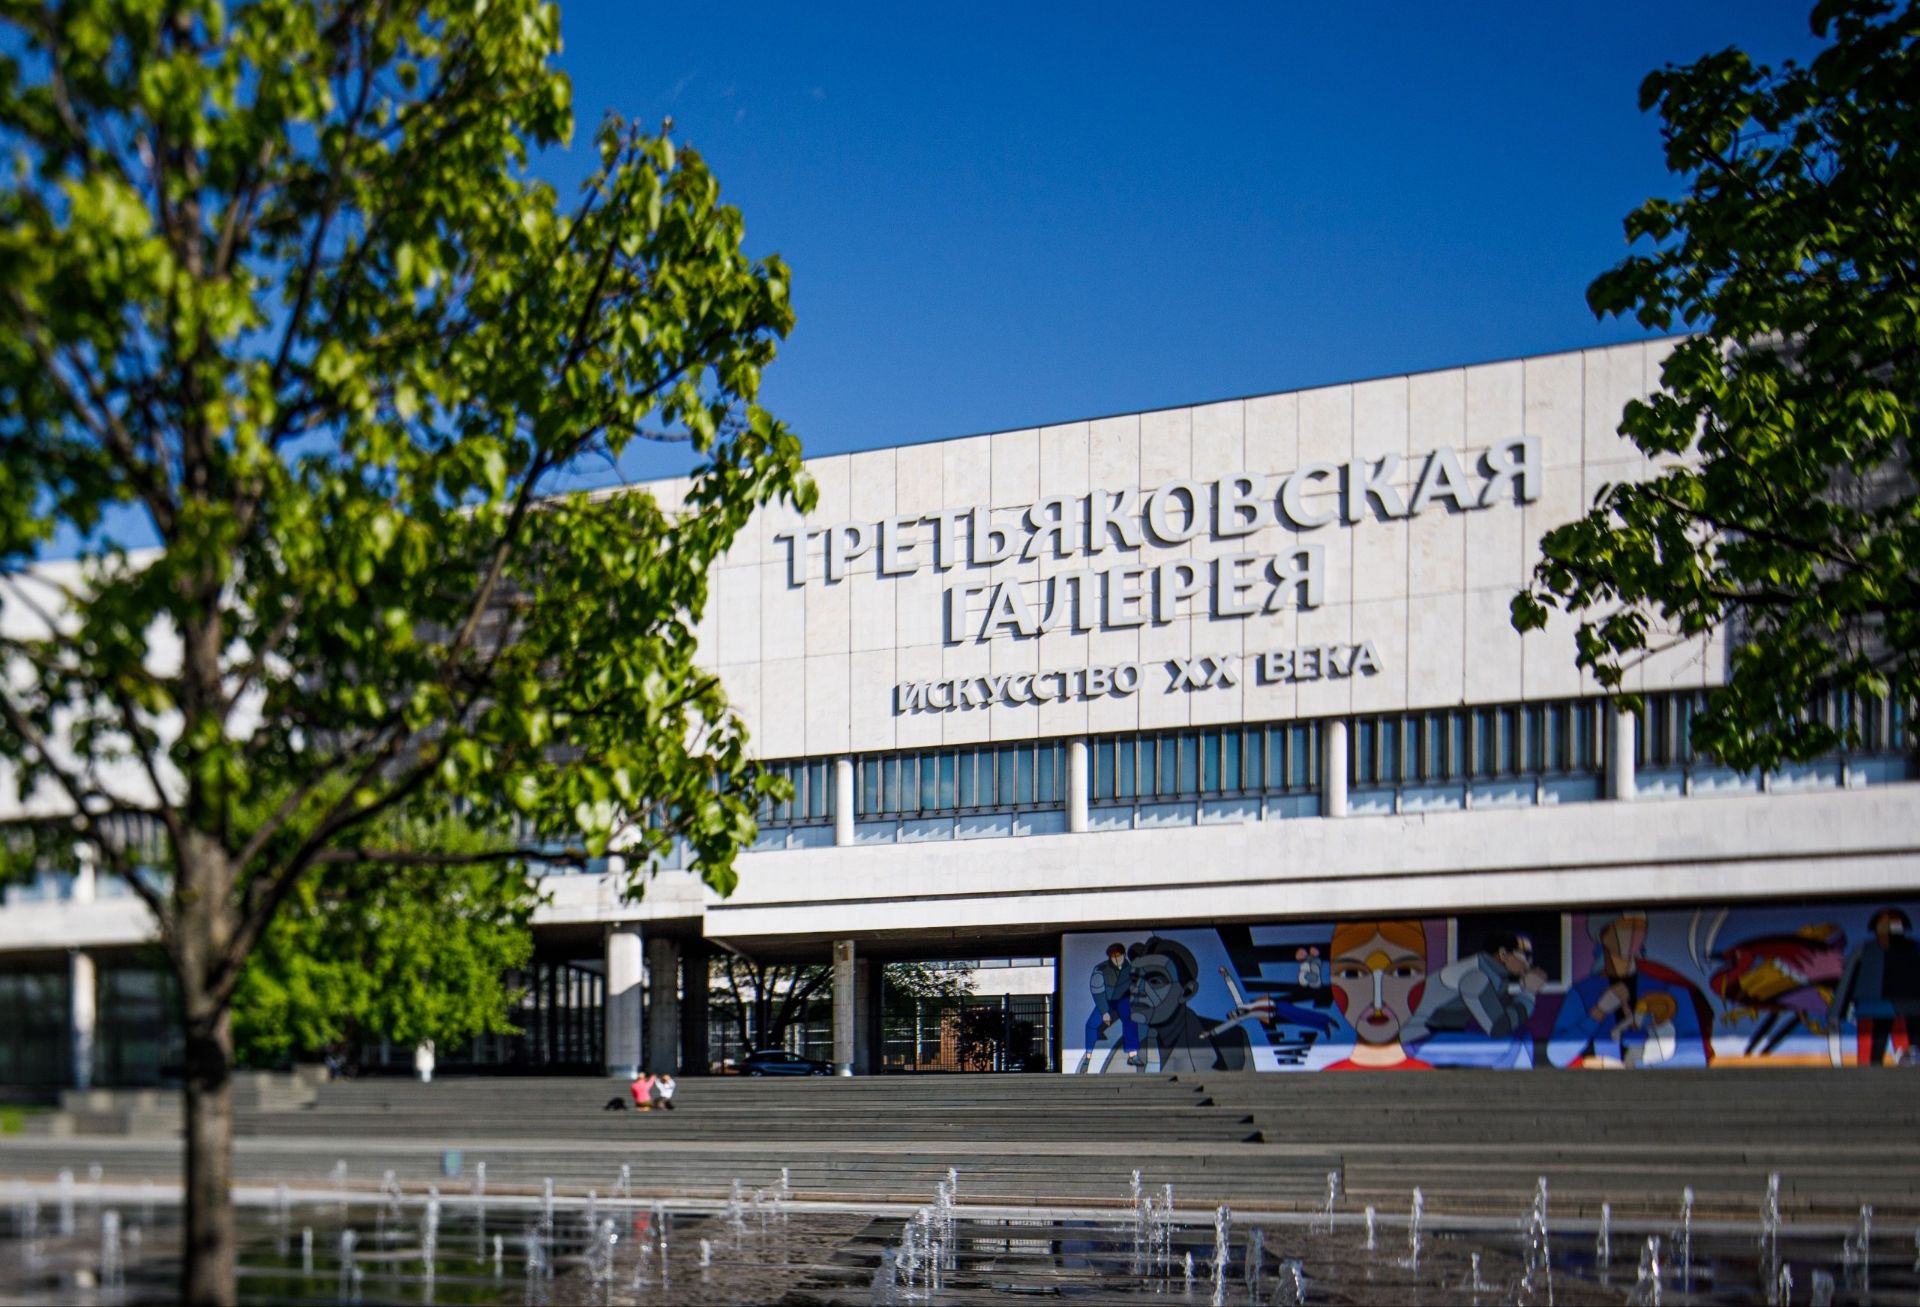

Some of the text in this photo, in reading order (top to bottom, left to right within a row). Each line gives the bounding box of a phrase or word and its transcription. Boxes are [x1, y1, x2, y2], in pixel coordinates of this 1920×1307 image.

[774, 435, 1541, 588] ТРЕТЬЯКОВСКАЯ
[943, 543, 1325, 645] ГАЛЕРЕЯ
[893, 662, 1145, 716] ИСКУССТВО
[1257, 640, 1384, 686] ВЕКА
